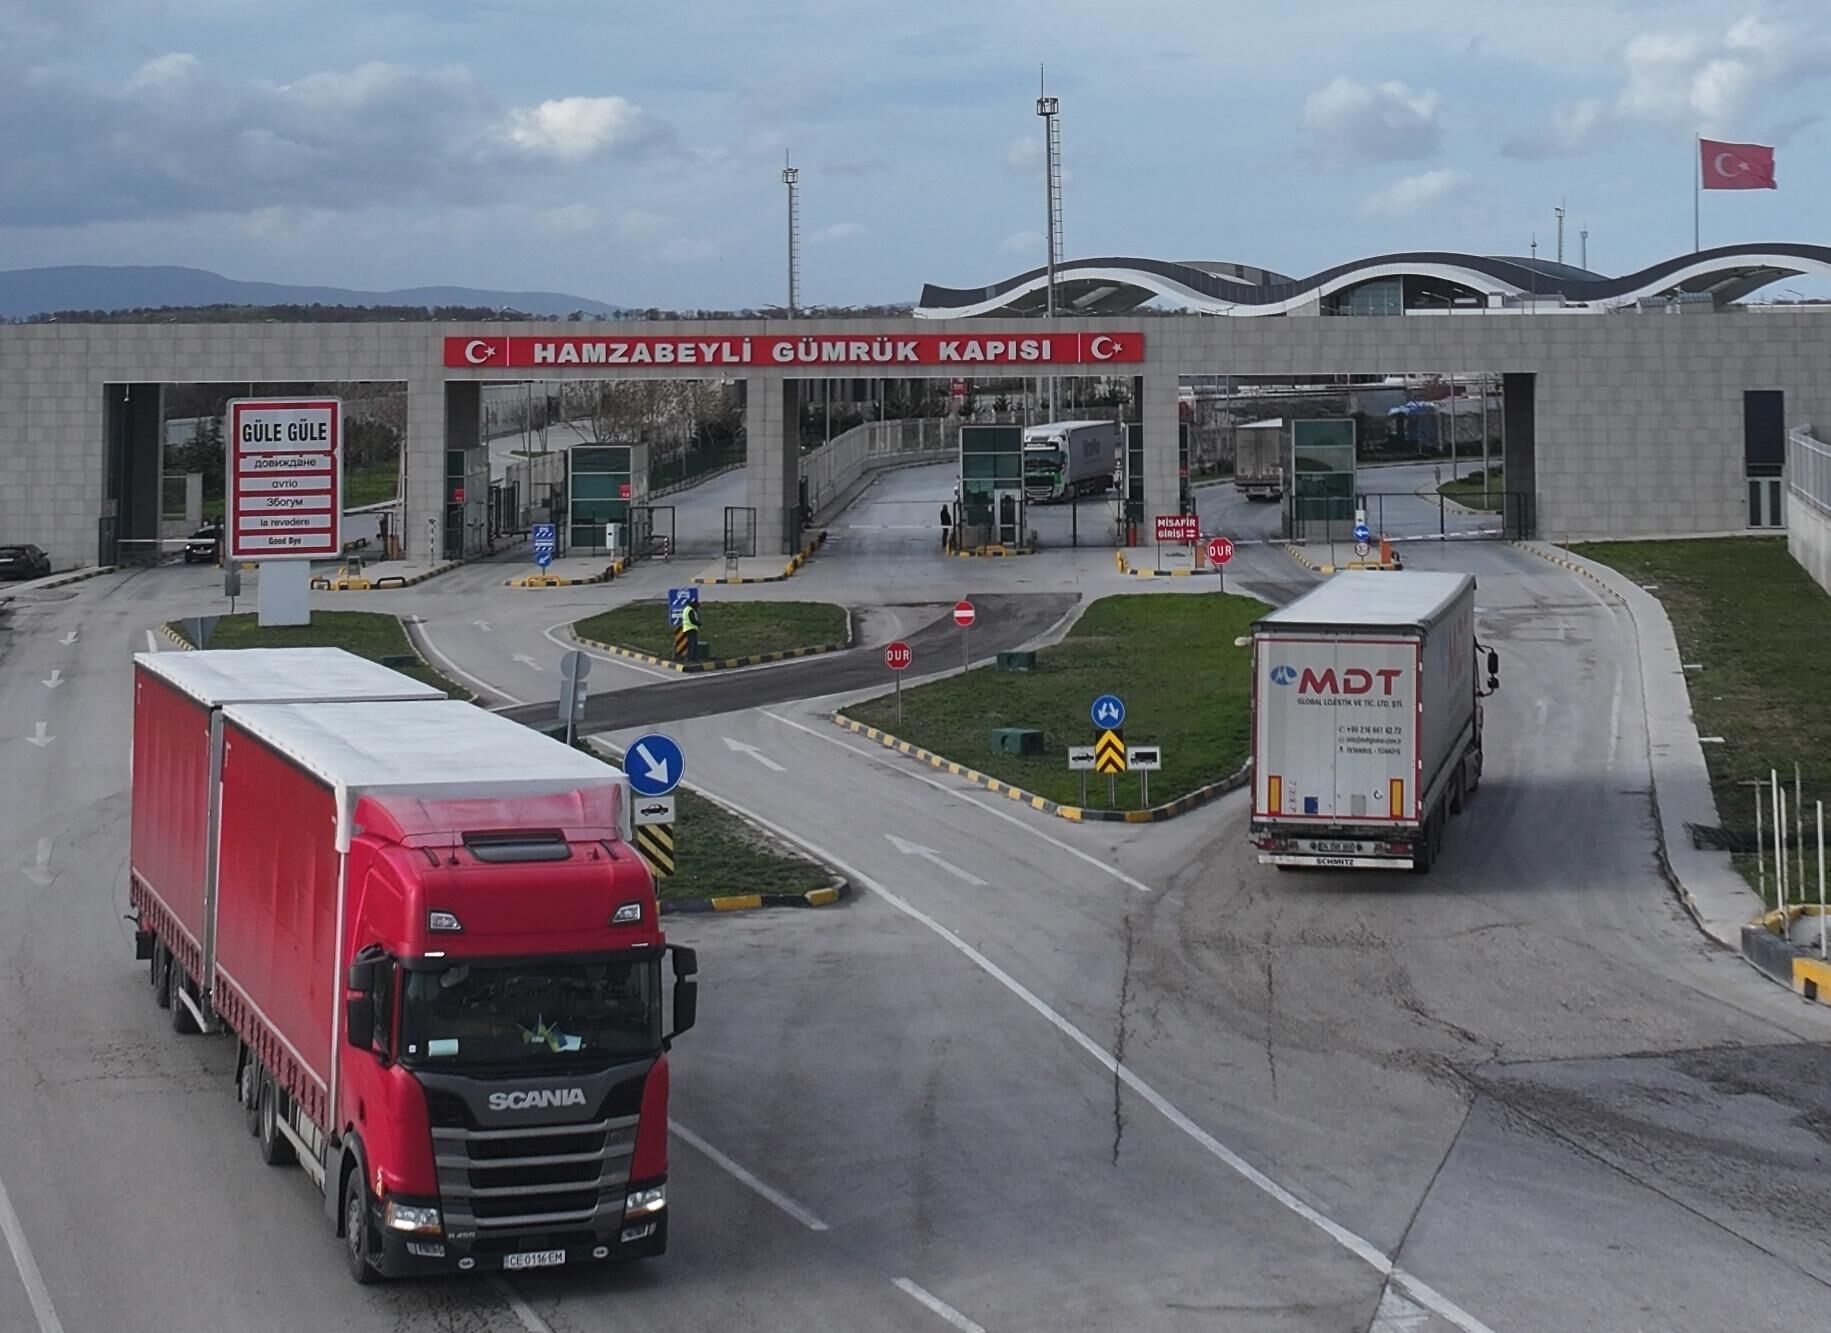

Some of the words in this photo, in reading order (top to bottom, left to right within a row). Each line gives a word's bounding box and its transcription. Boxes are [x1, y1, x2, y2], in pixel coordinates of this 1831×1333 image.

[534, 338, 751, 364] HAMZABEYLİ
[772, 336, 919, 362] GÜMRÜK
[939, 339, 1051, 361] KAPISI
[242, 419, 282, 442] GÜLE
[288, 418, 327, 441] GÜLE
[254, 458, 317, 469] довиждане
[266, 497, 304, 508] Збогум
[270, 517, 310, 527] revedere
[268, 536, 286, 545] Good
[288, 536, 302, 545] Bye
[1209, 544, 1232, 557] DUR
[887, 648, 910, 661] DUR
[1298, 667, 1403, 696] MDT
[1297, 698, 1322, 706] GLOBAL
[1316, 858, 1354, 866] SCHMITZ
[488, 1088, 586, 1111] SCANIA
